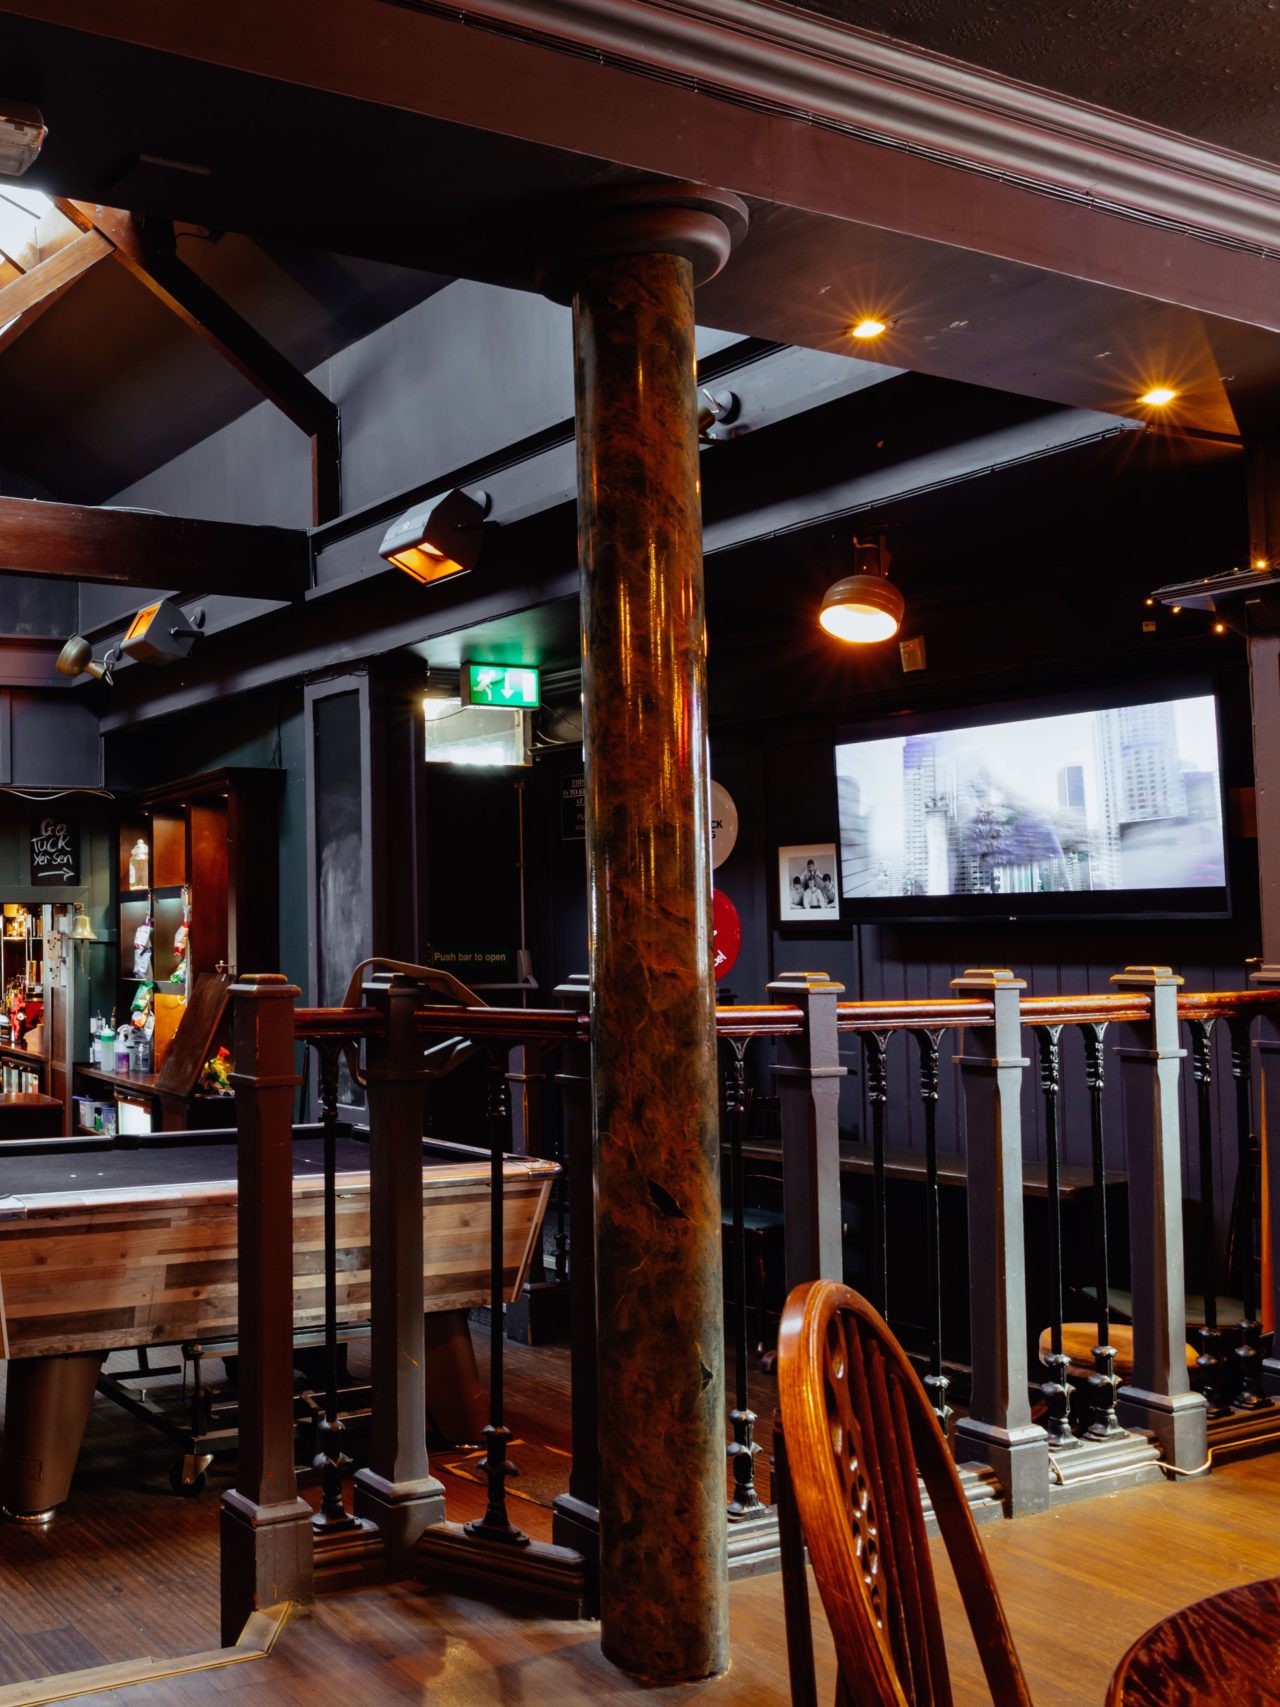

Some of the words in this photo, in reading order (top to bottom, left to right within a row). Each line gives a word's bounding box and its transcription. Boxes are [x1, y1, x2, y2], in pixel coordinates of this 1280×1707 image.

[434, 952, 456, 961] Push
[458, 952, 472, 961] bar
[474, 952, 483, 961] to
[485, 953, 506, 963] open
